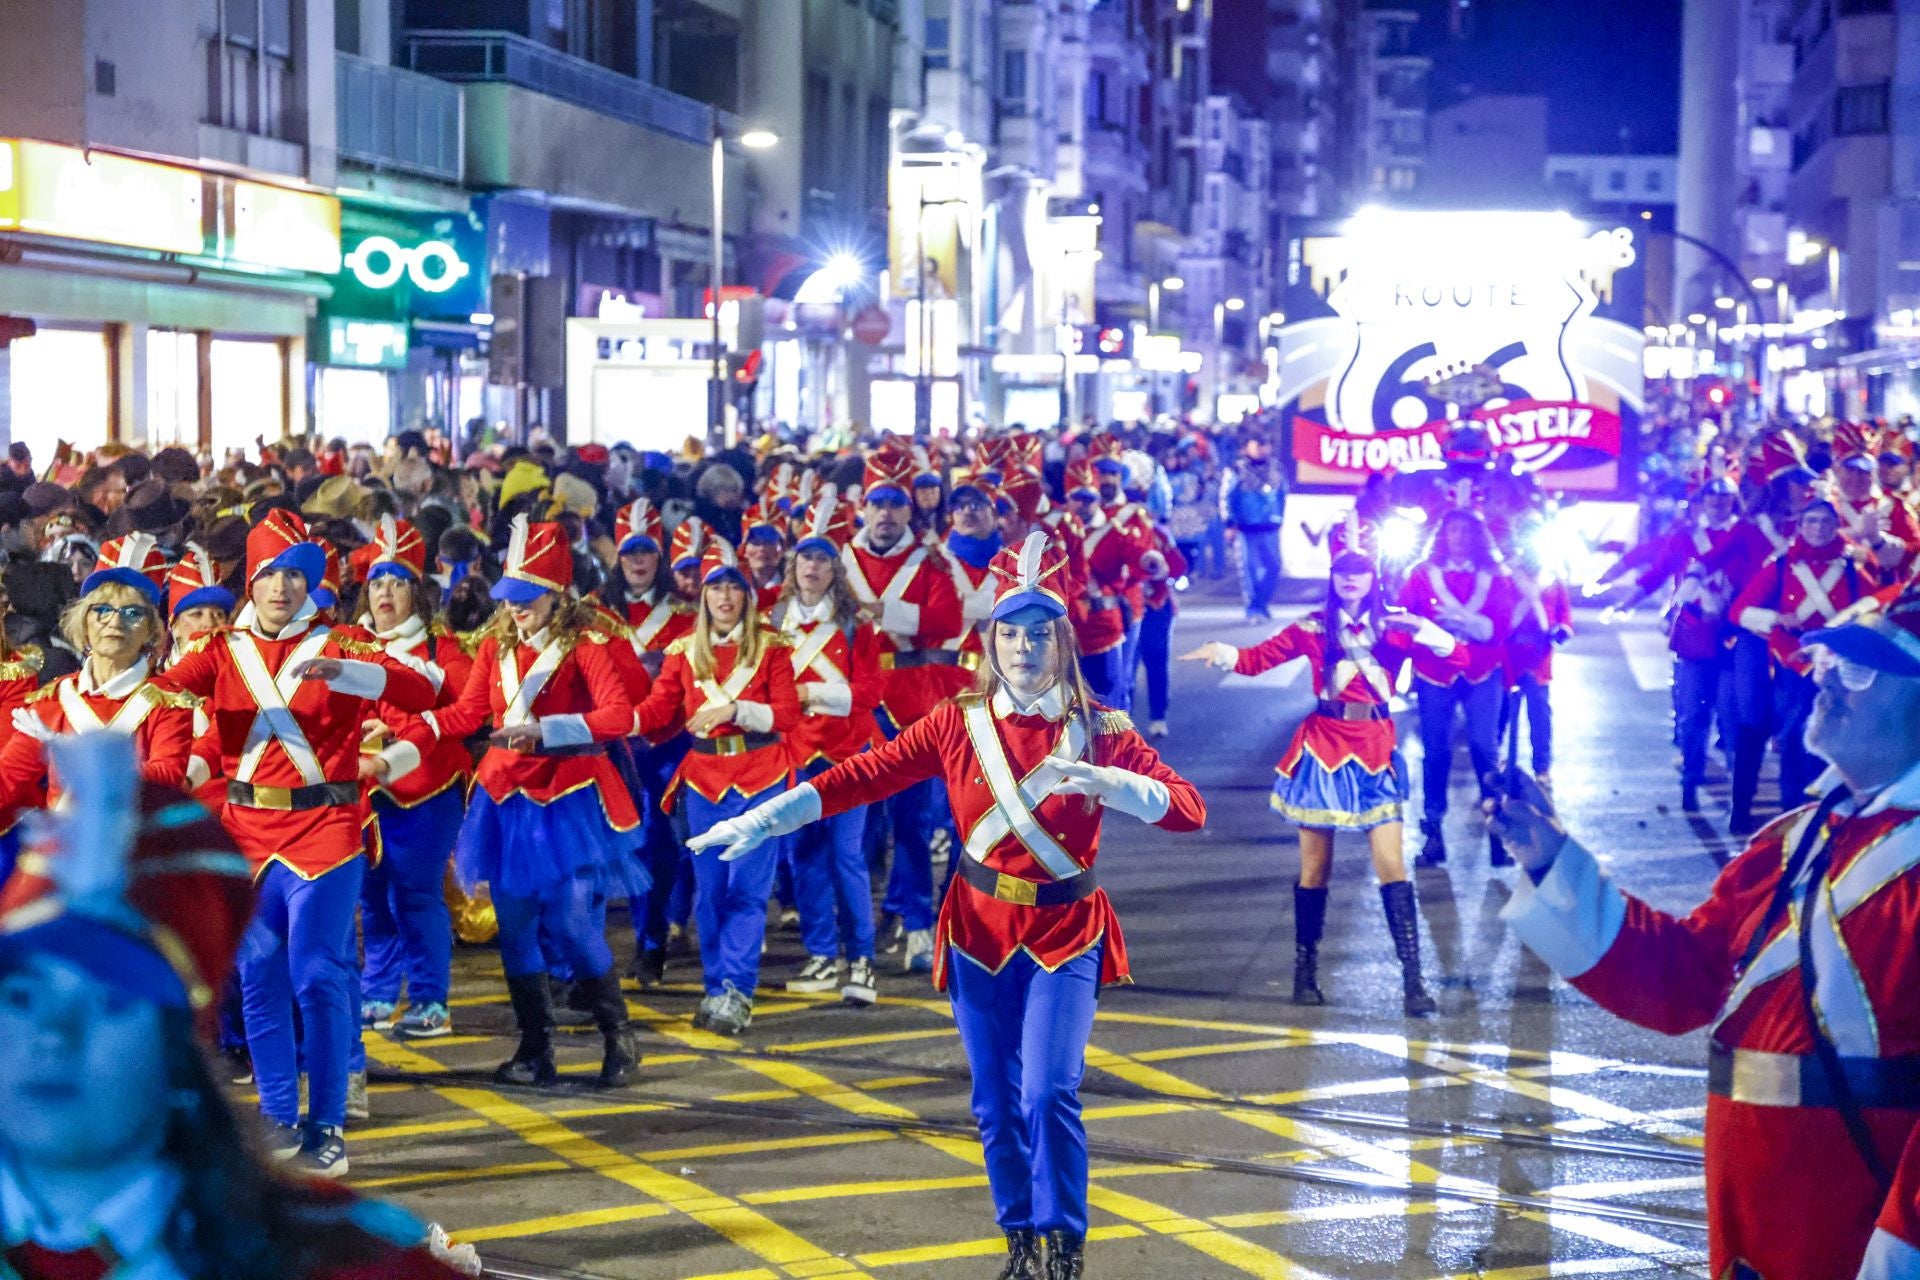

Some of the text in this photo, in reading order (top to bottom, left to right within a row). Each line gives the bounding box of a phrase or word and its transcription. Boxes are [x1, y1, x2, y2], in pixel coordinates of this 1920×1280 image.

[1395, 283, 1528, 307] ROUTE
[1372, 340, 1535, 434] 66
[1319, 406, 1594, 471] VITORIA STEIZ
